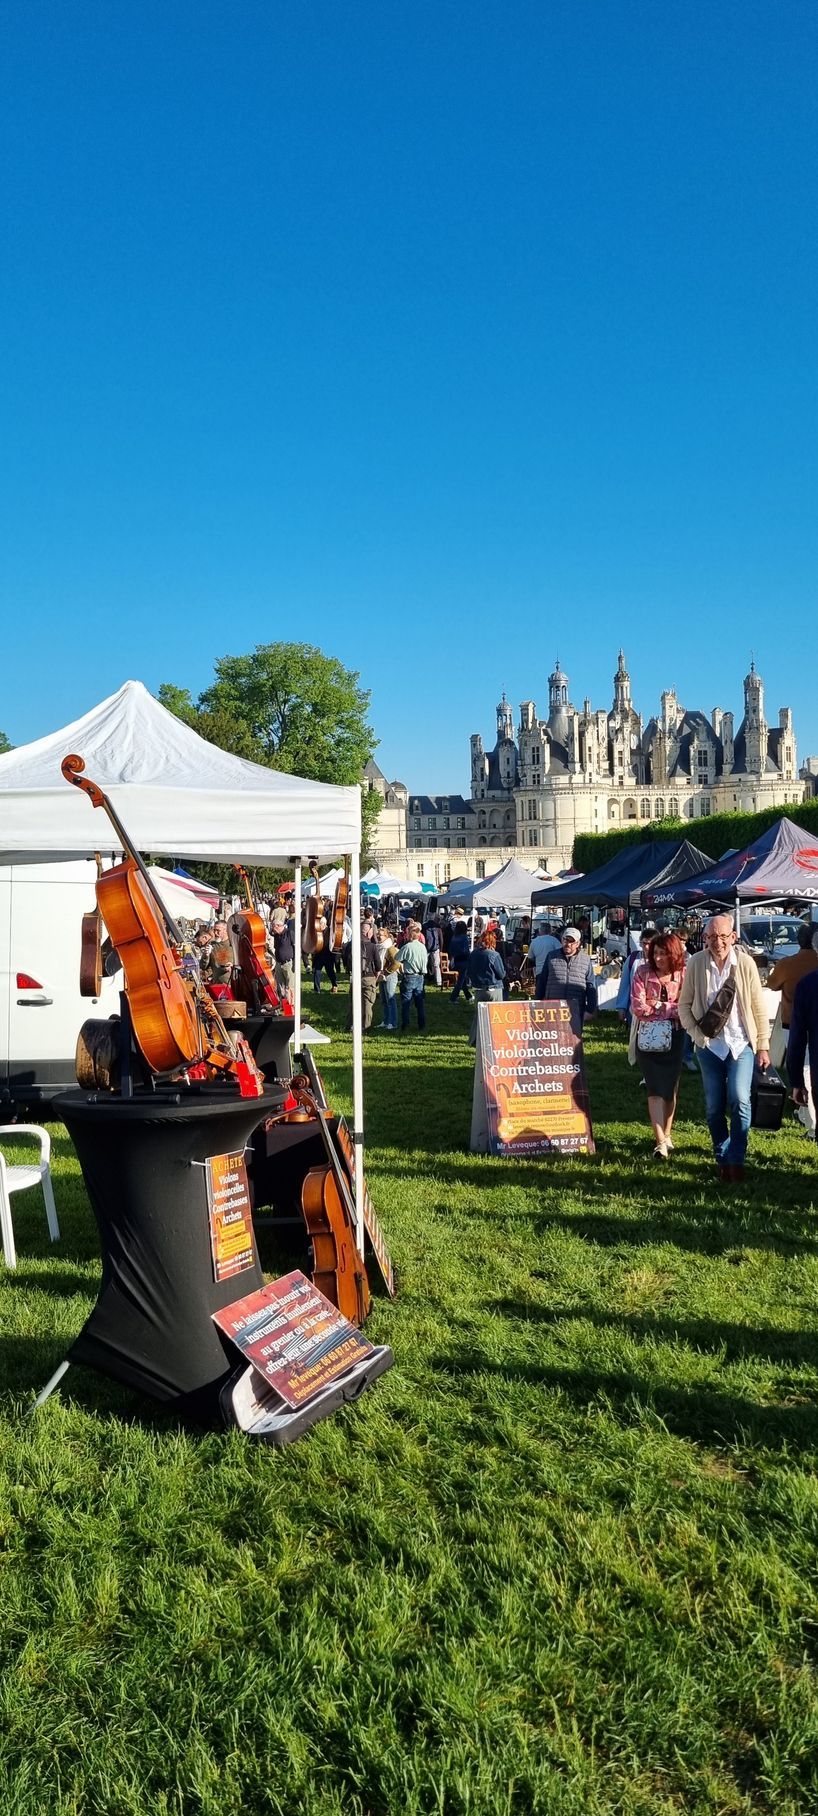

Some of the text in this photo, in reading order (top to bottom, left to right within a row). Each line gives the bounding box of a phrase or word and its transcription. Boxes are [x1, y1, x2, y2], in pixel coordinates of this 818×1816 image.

[653, 893, 675, 904] 24MX
[491, 1008, 572, 1024] ACHETE
[506, 1028, 558, 1041] Violons
[493, 1044, 574, 1060] violoncelles
[490, 1062, 580, 1077] Contrebasses
[512, 1080, 563, 1093] Archets
[496, 1142, 506, 1150] Mr
[230, 1319, 246, 1331] Ne
[241, 1305, 268, 1325] laissez
[264, 1301, 282, 1314] pas
[304, 1315, 317, 1326] la
[244, 1314, 288, 1344] instruments
[292, 1325, 305, 1335] ou
[300, 1320, 310, 1329] à
[268, 1329, 298, 1351] grenier
[298, 1338, 315, 1351] une
[259, 1344, 273, 1356] au
[287, 1377, 300, 1389] Mr
[319, 1356, 330, 1366] 06
[341, 1341, 352, 1351] 27
